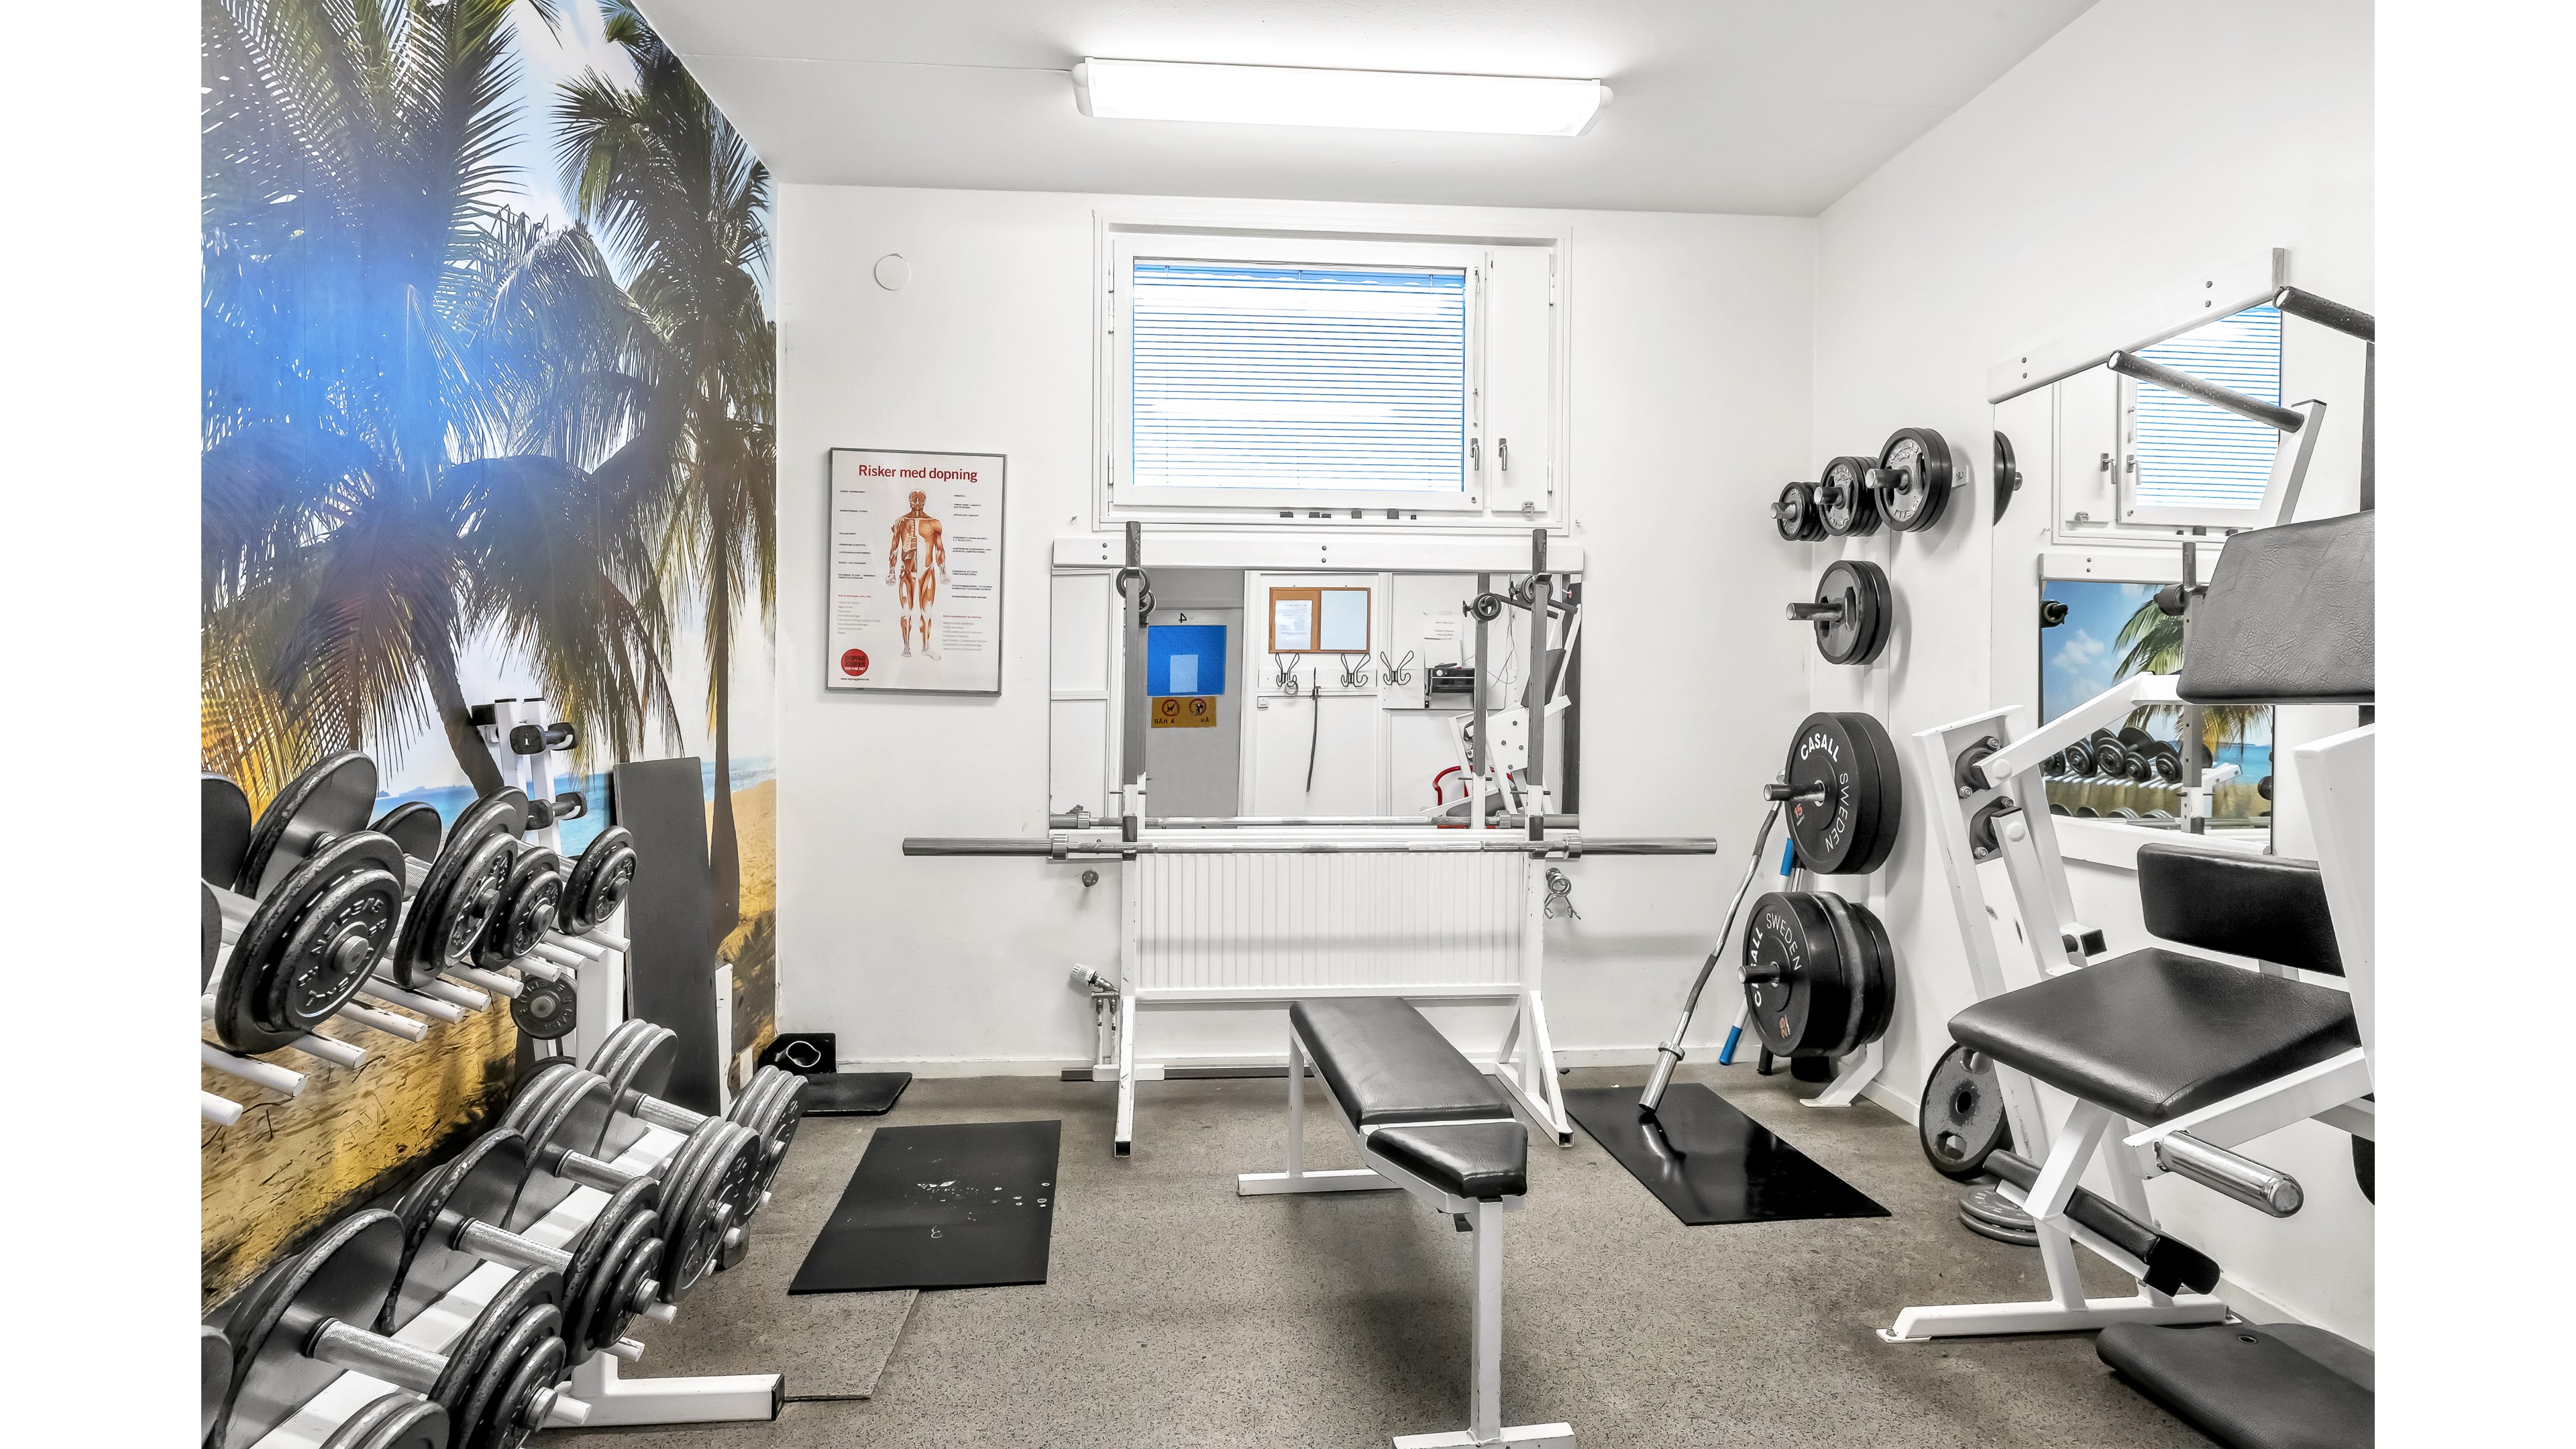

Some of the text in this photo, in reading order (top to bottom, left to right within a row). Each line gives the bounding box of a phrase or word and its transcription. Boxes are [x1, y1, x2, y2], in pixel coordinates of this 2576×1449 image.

[858, 465, 978, 483] Risker med dopning
[1794, 803, 1803, 818] 15
[1801, 733, 1849, 853] CASALL SWEDEN
[1751, 912, 1802, 1008] CALL SWEDEN
